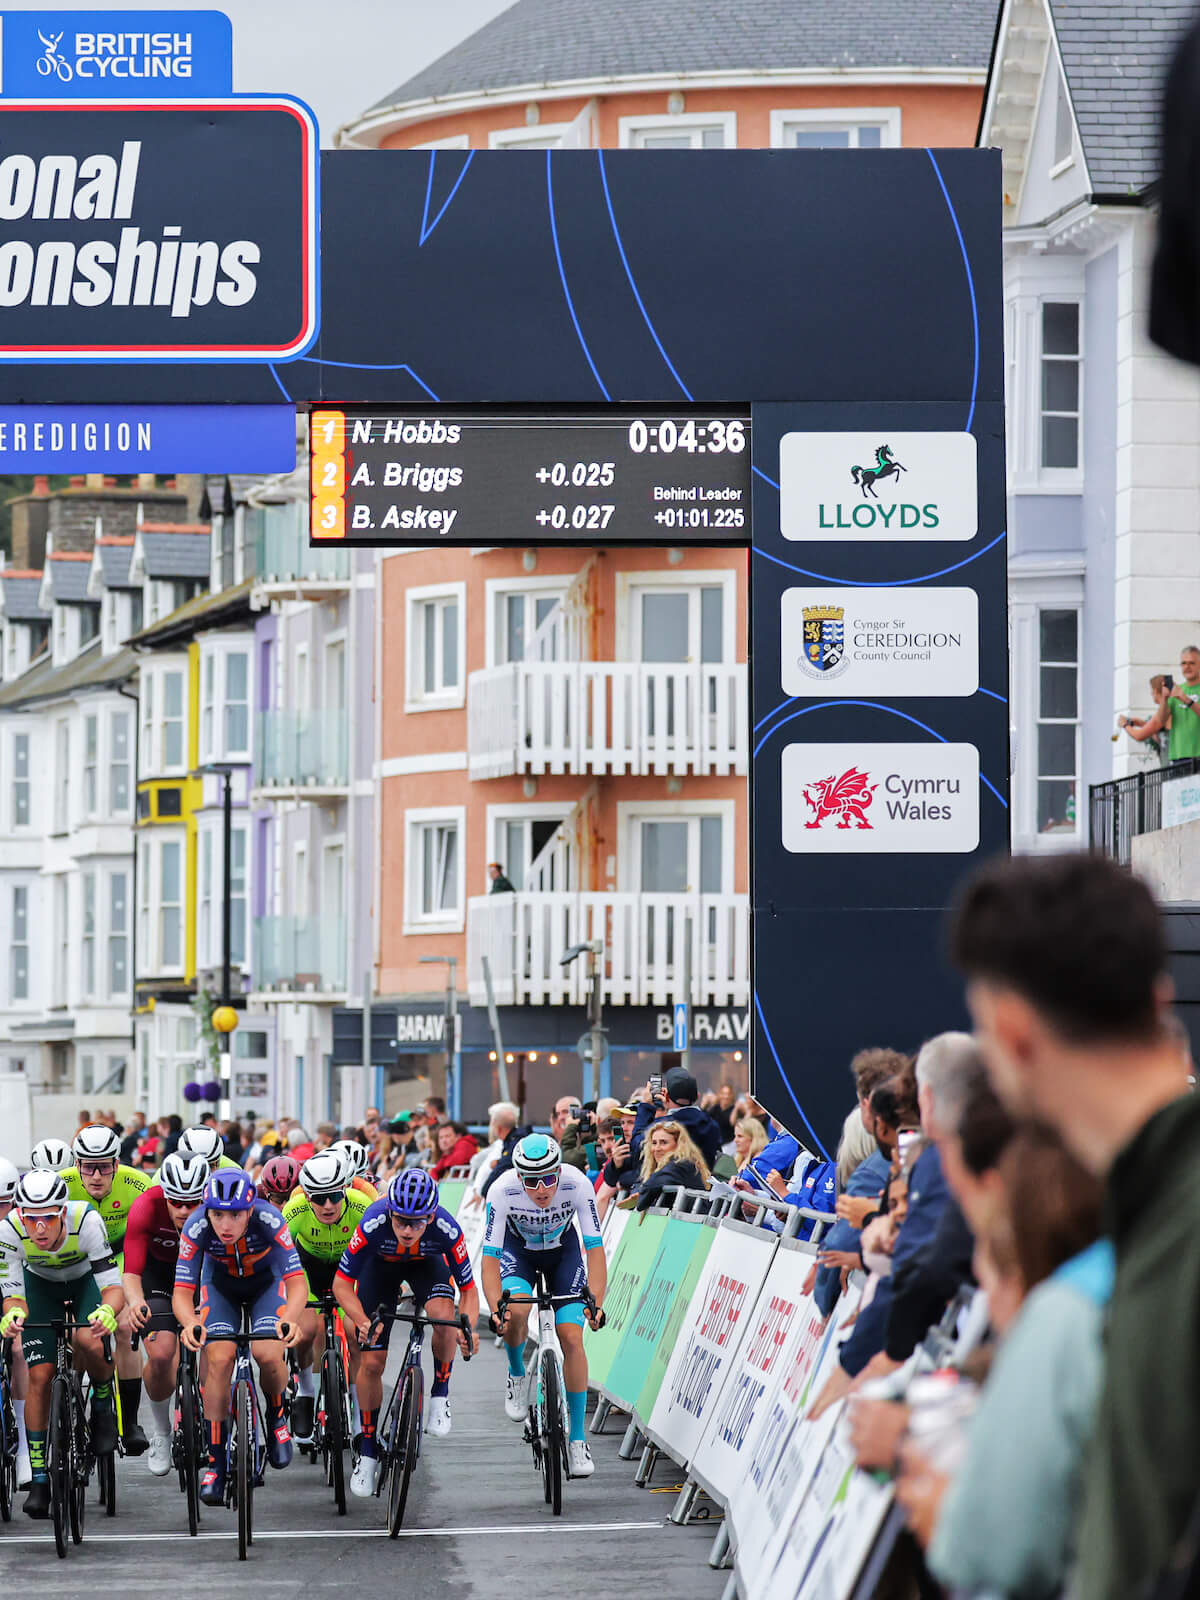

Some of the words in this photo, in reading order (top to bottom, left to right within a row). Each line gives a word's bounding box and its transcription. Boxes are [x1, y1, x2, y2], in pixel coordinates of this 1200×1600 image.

[75, 33, 193, 55] BRITISH
[75, 57, 193, 78] CYCLING
[322, 421, 335, 443] 1
[352, 421, 374, 443] N.
[384, 420, 461, 444] Hobbs
[629, 421, 746, 453] 0:04:36
[322, 464, 337, 486] 2
[352, 464, 375, 486] A.
[384, 463, 463, 492] Briggs
[535, 463, 616, 486] +0.025
[654, 487, 696, 500] Behind
[699, 487, 742, 500] Leader
[321, 506, 337, 528] 3
[352, 506, 375, 528] B.
[382, 505, 458, 534] Askey
[535, 506, 616, 529] +0.027
[654, 509, 745, 528] +01:01.225
[818, 503, 940, 528] LLOYDS
[853, 619, 890, 631] Cyngor
[893, 619, 905, 630] Sir
[853, 633, 962, 648] CEREDIGION
[853, 650, 889, 662] County
[892, 650, 931, 661] Council
[885, 773, 961, 799] Cymru
[886, 800, 952, 821] Wales
[397, 1014, 446, 1042] BARAV
[656, 1013, 750, 1041] BRAV
